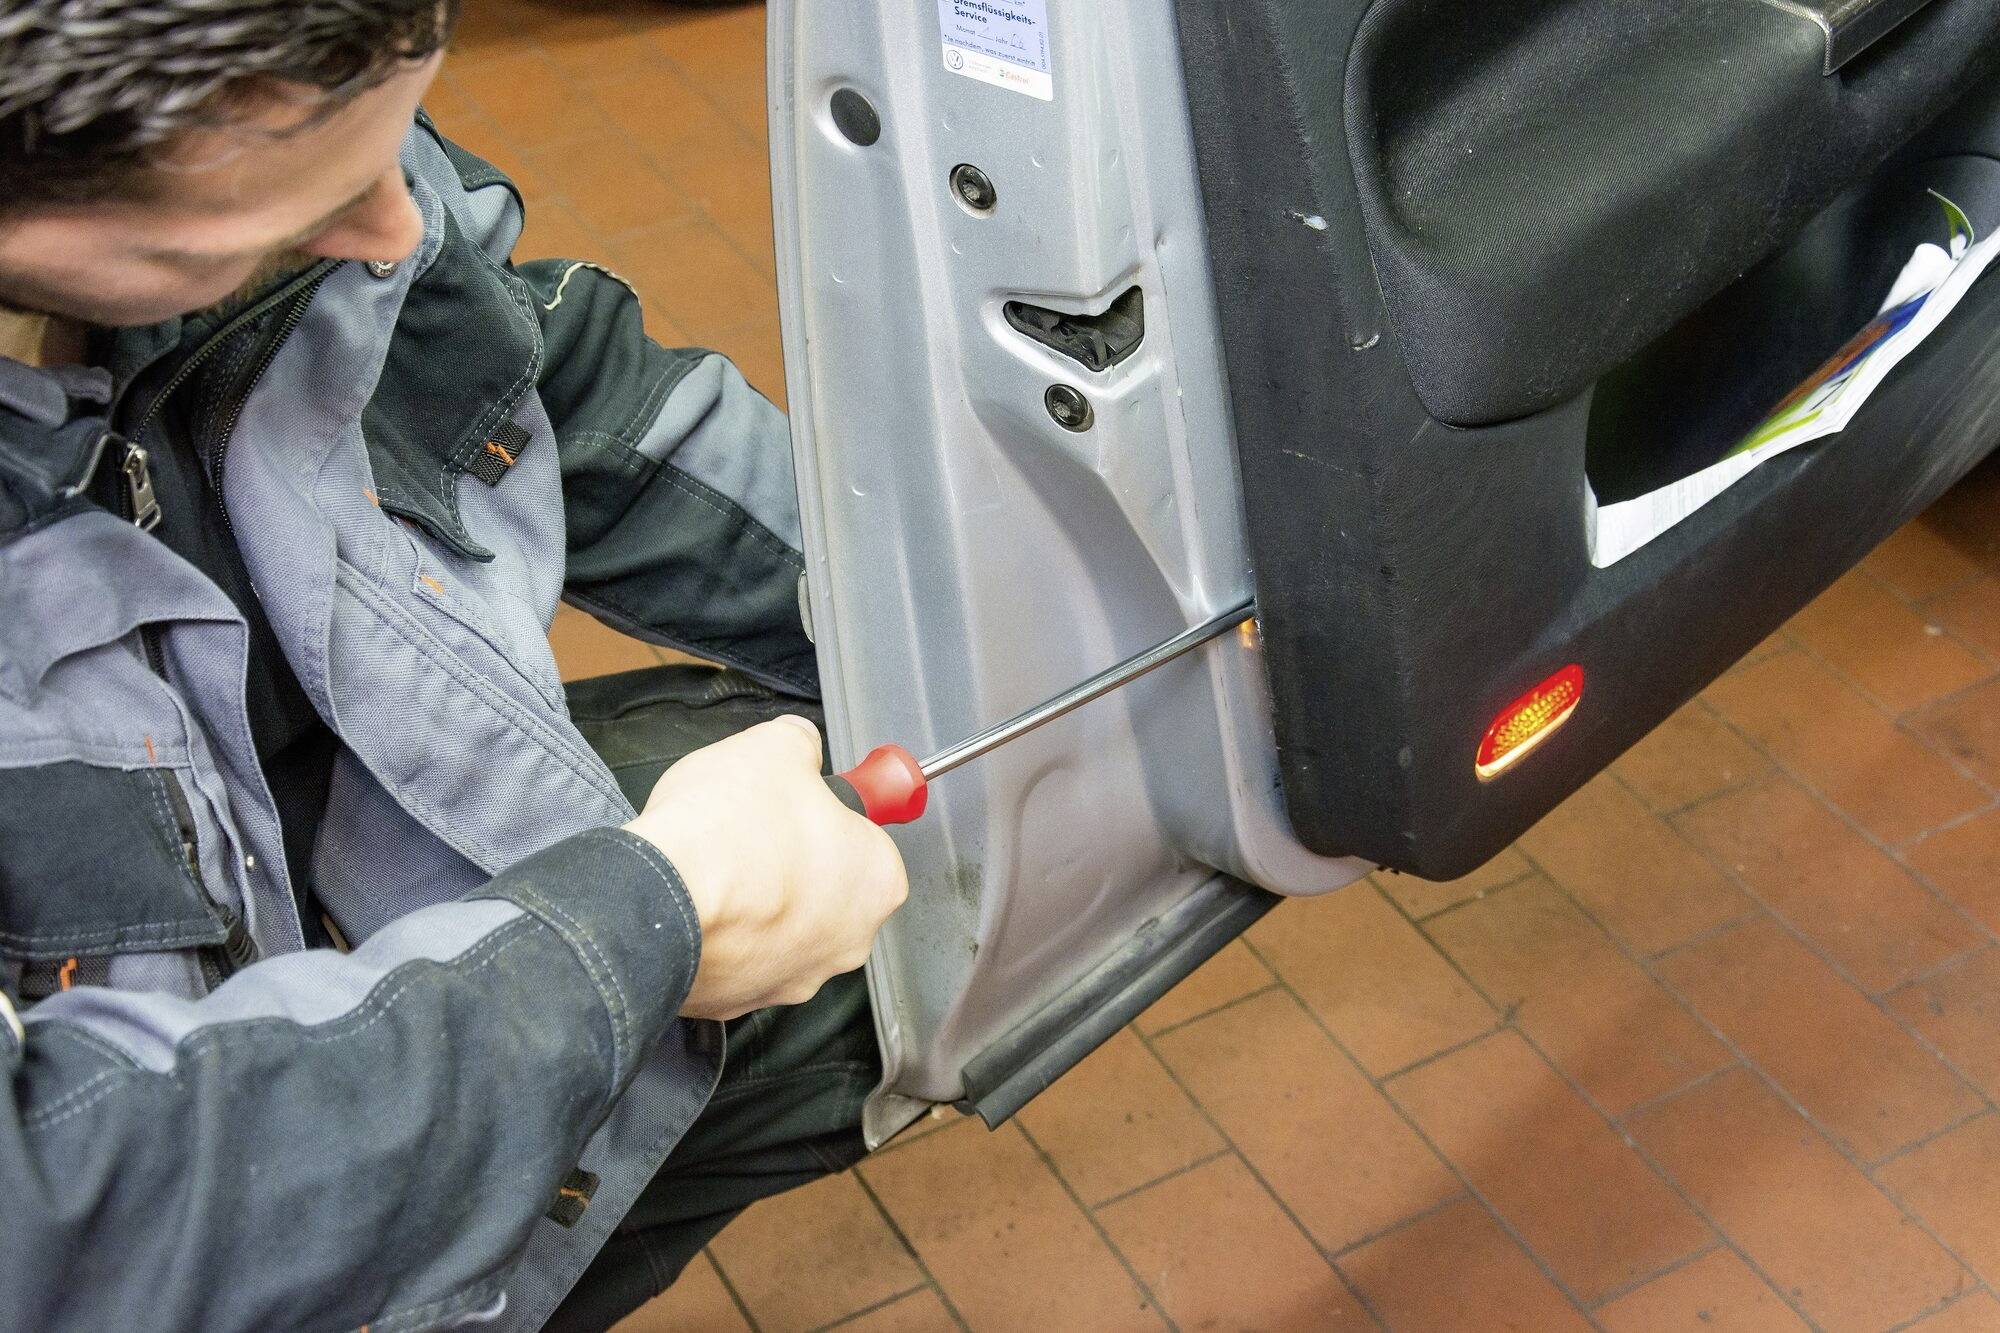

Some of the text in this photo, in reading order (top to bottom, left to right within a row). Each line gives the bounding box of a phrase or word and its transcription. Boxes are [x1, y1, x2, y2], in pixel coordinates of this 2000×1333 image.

[954, 6, 988, 24] Service
[956, 24, 976, 36] Monat
[995, 35, 1008, 45] Jahr
[985, 48, 997, 56] was
